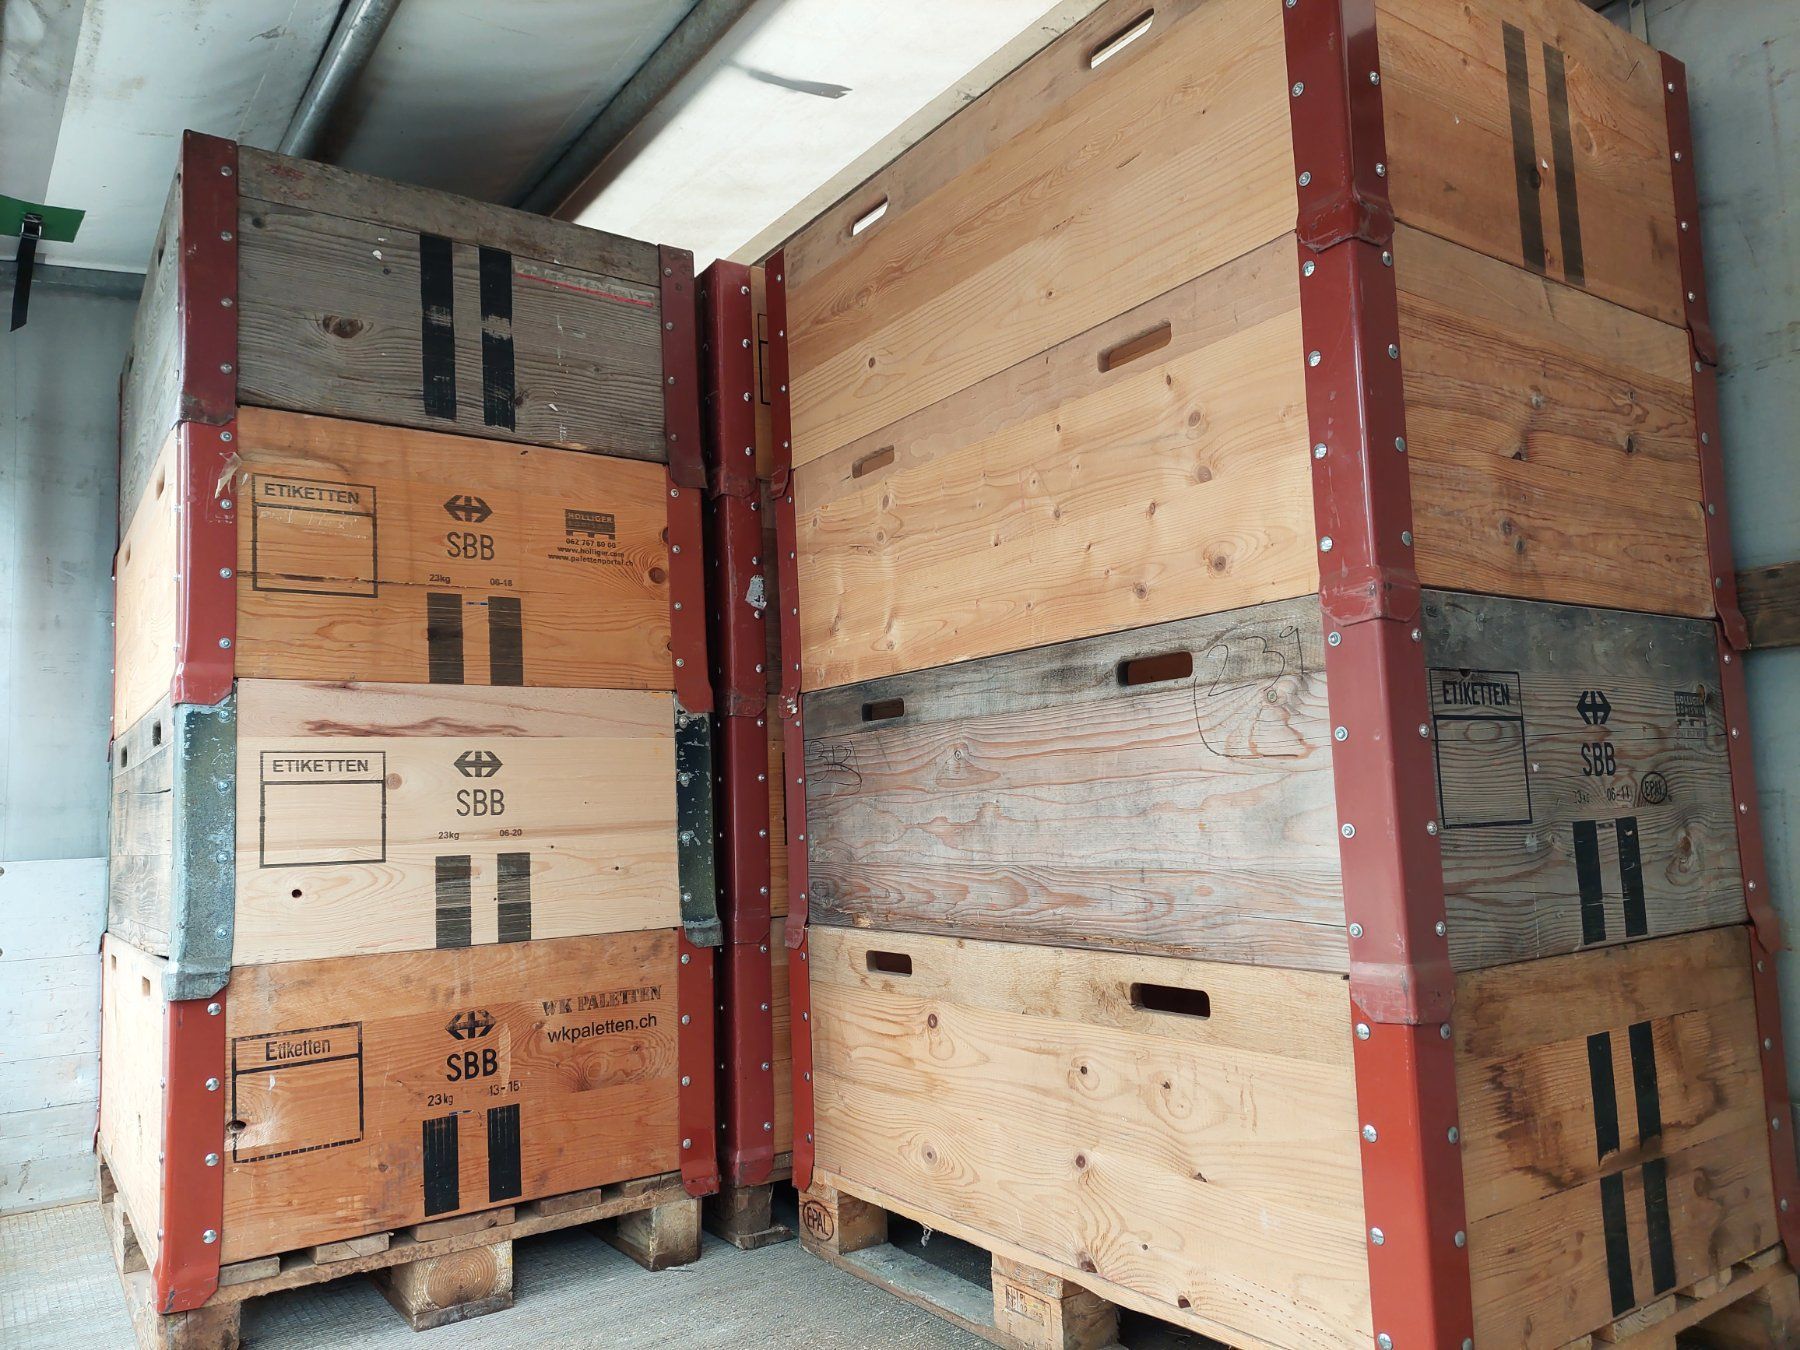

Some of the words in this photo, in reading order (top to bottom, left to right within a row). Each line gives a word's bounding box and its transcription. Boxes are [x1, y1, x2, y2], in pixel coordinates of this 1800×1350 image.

[264, 482, 360, 505] ETIKETTEN
[446, 531, 495, 561] SBB
[557, 546, 625, 559] www.holliger.com
[547, 553, 634, 567] www.palettenportal.ch
[429, 573, 451, 585] 23kg
[1442, 680, 1510, 706] ETIKETTEN
[272, 759, 369, 773] ETIKETTEN
[1581, 741, 1617, 777] SBB
[456, 788, 505, 817] SBB
[438, 830, 460, 841] 23kg
[499, 828, 523, 837] 06-20
[547, 1013, 657, 1043] wkpaletten.ch
[265, 1039, 331, 1062] Etiketten
[446, 1048, 498, 1082] SBB
[806, 1206, 830, 1237] EPAL
